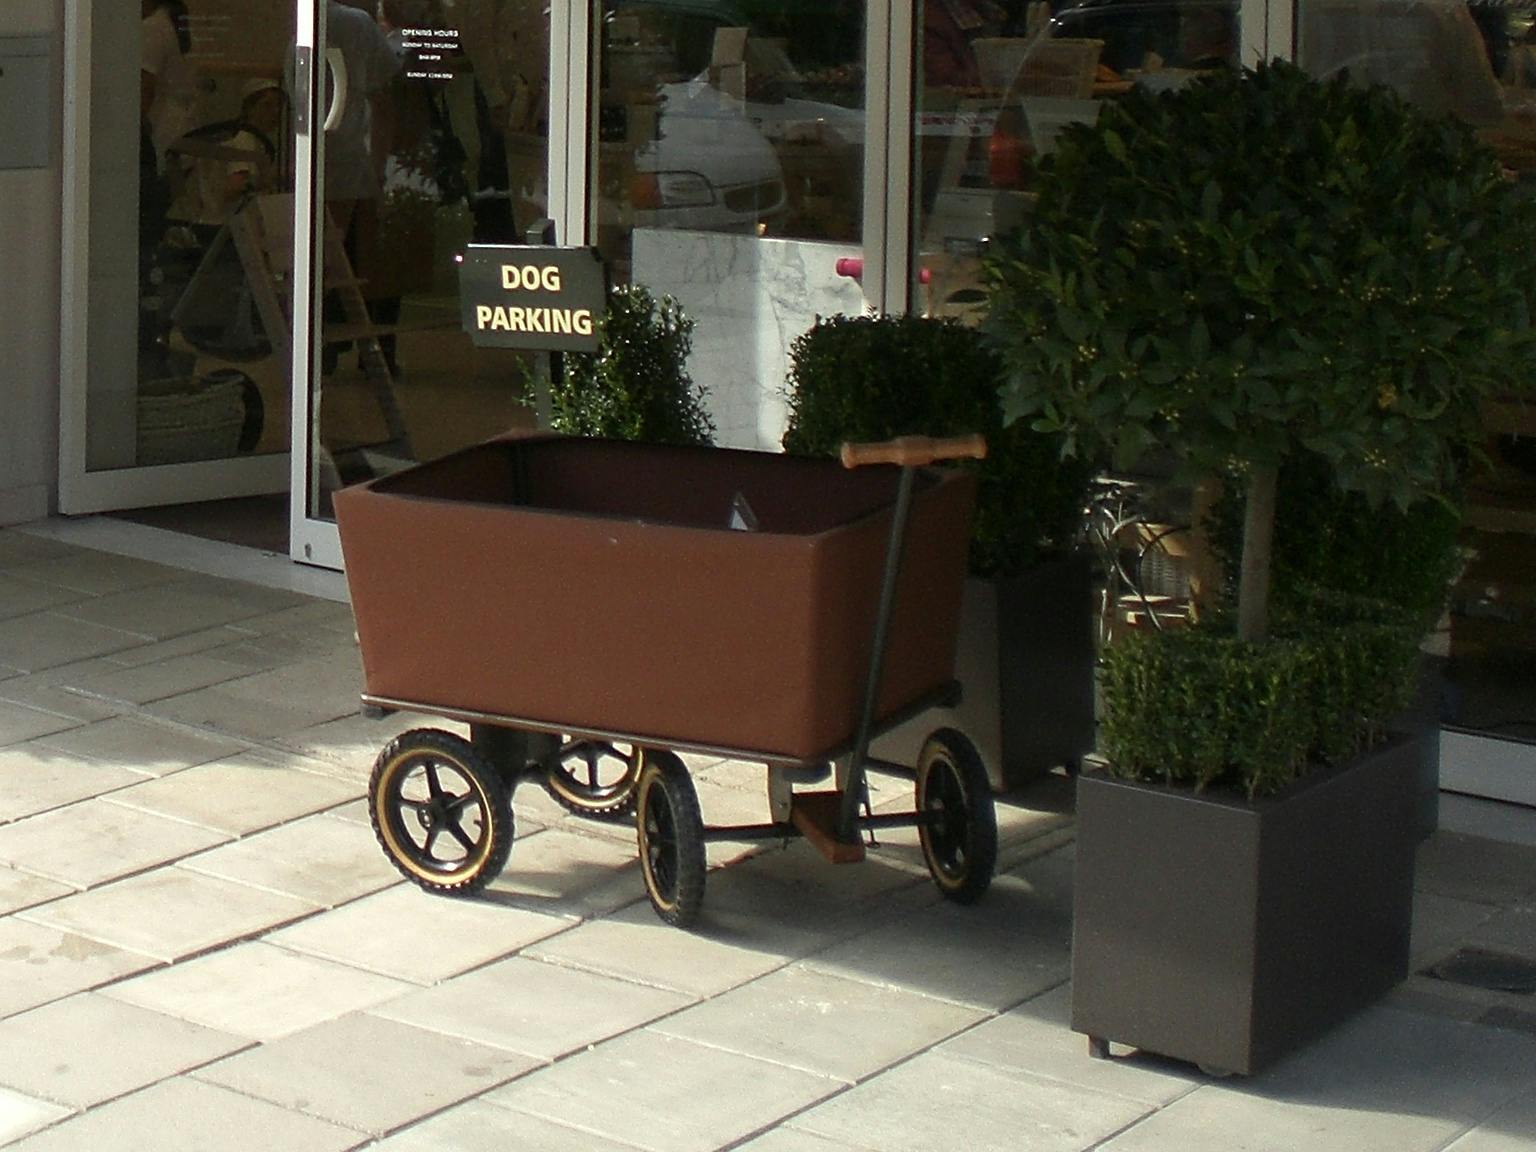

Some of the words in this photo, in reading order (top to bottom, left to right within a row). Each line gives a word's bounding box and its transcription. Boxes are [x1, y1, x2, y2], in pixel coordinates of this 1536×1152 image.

[401, 29, 432, 37] OPENING
[433, 30, 459, 38] HOURS
[501, 264, 561, 291] DOG
[476, 305, 593, 336] PARKING
